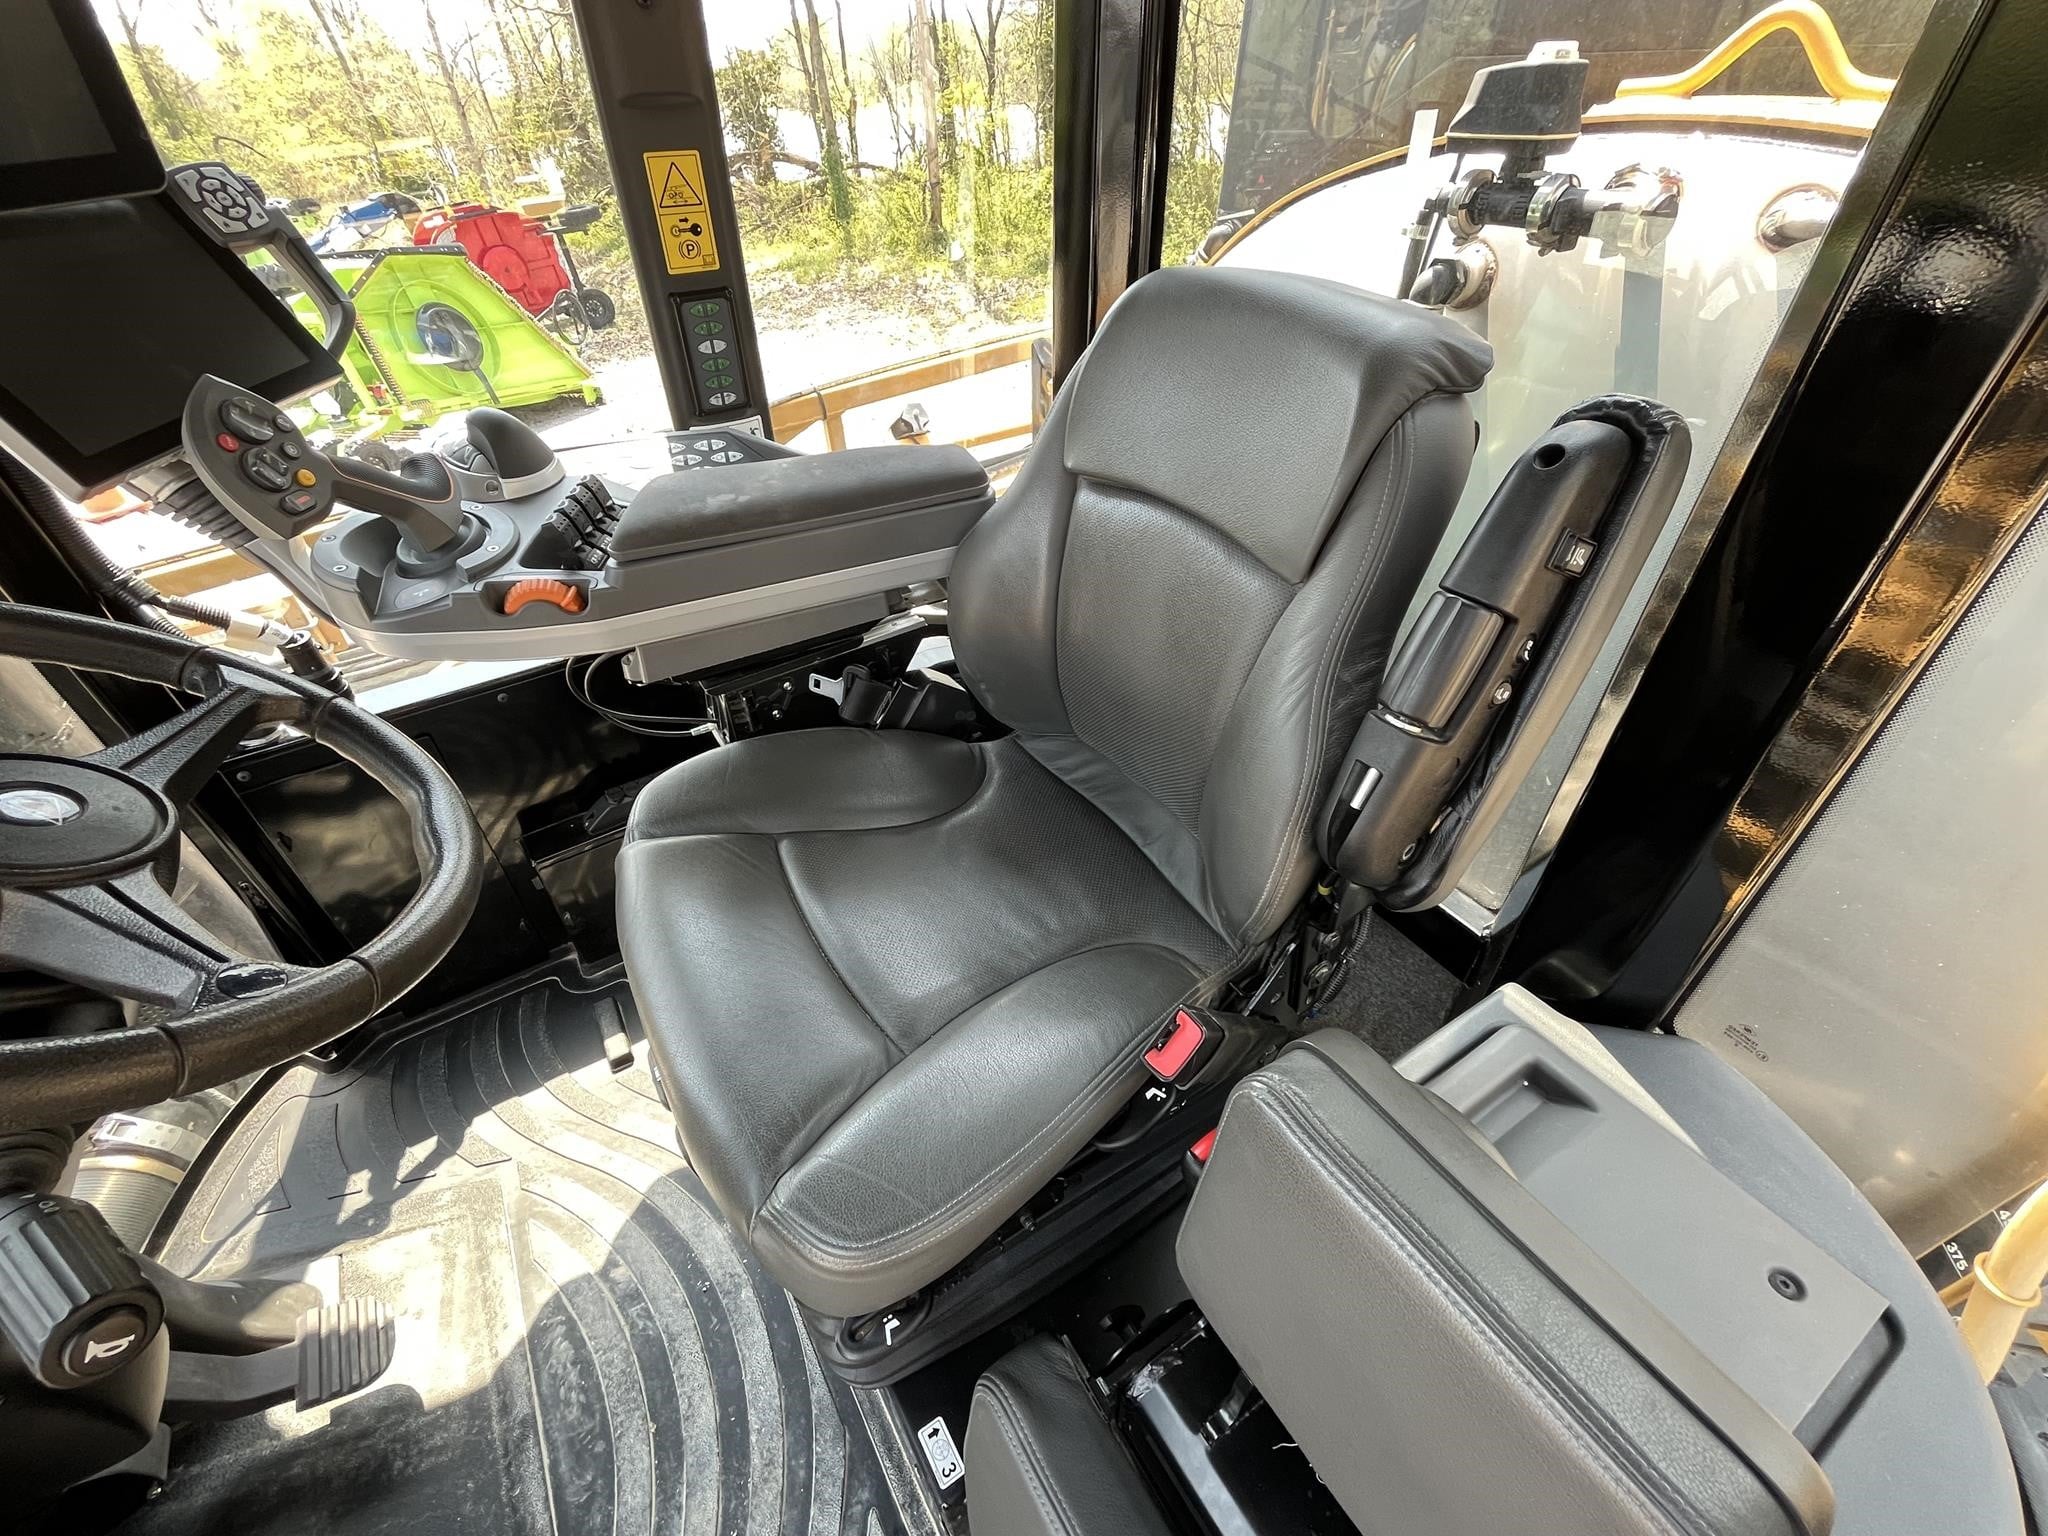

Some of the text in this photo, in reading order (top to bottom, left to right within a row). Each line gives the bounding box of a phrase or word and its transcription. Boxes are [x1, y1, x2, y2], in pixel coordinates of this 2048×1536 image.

[686, 243, 695, 256] P
[1946, 1241, 1969, 1271] 375
[942, 1461, 957, 1478] 3
